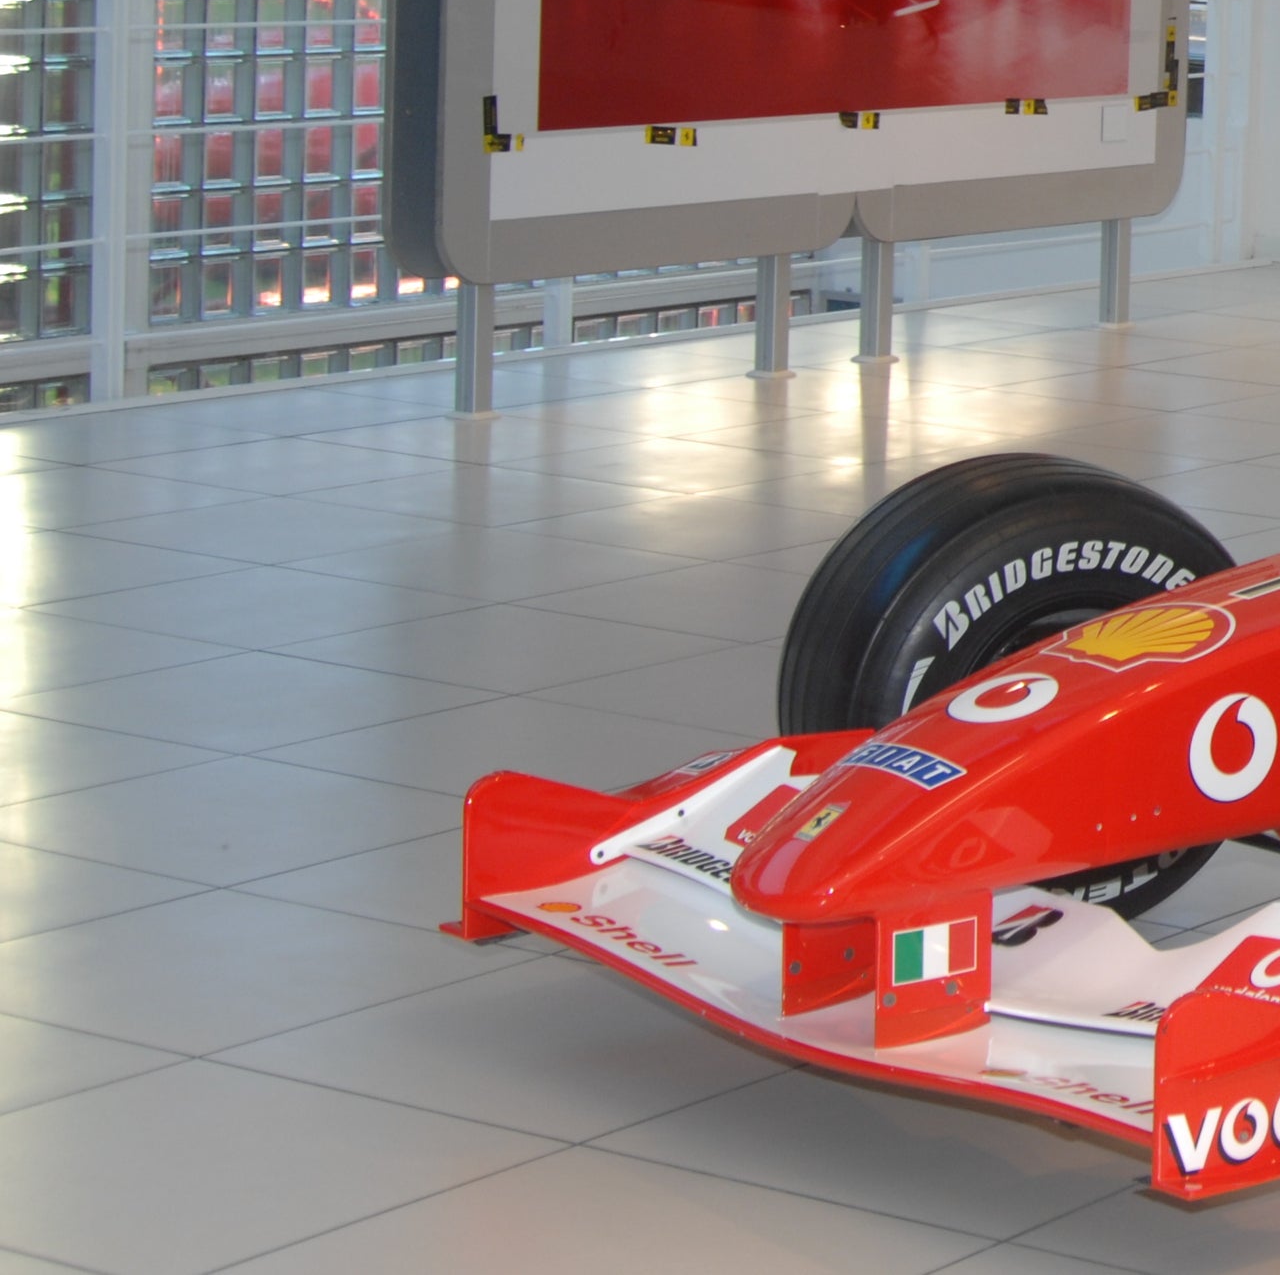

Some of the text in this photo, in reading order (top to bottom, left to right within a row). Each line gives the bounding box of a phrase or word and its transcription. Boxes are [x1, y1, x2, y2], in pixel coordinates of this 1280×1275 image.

[932, 538, 1197, 652] BRIDGESTONE
[847, 744, 957, 785] FIAT
[569, 914, 699, 969] Shell
